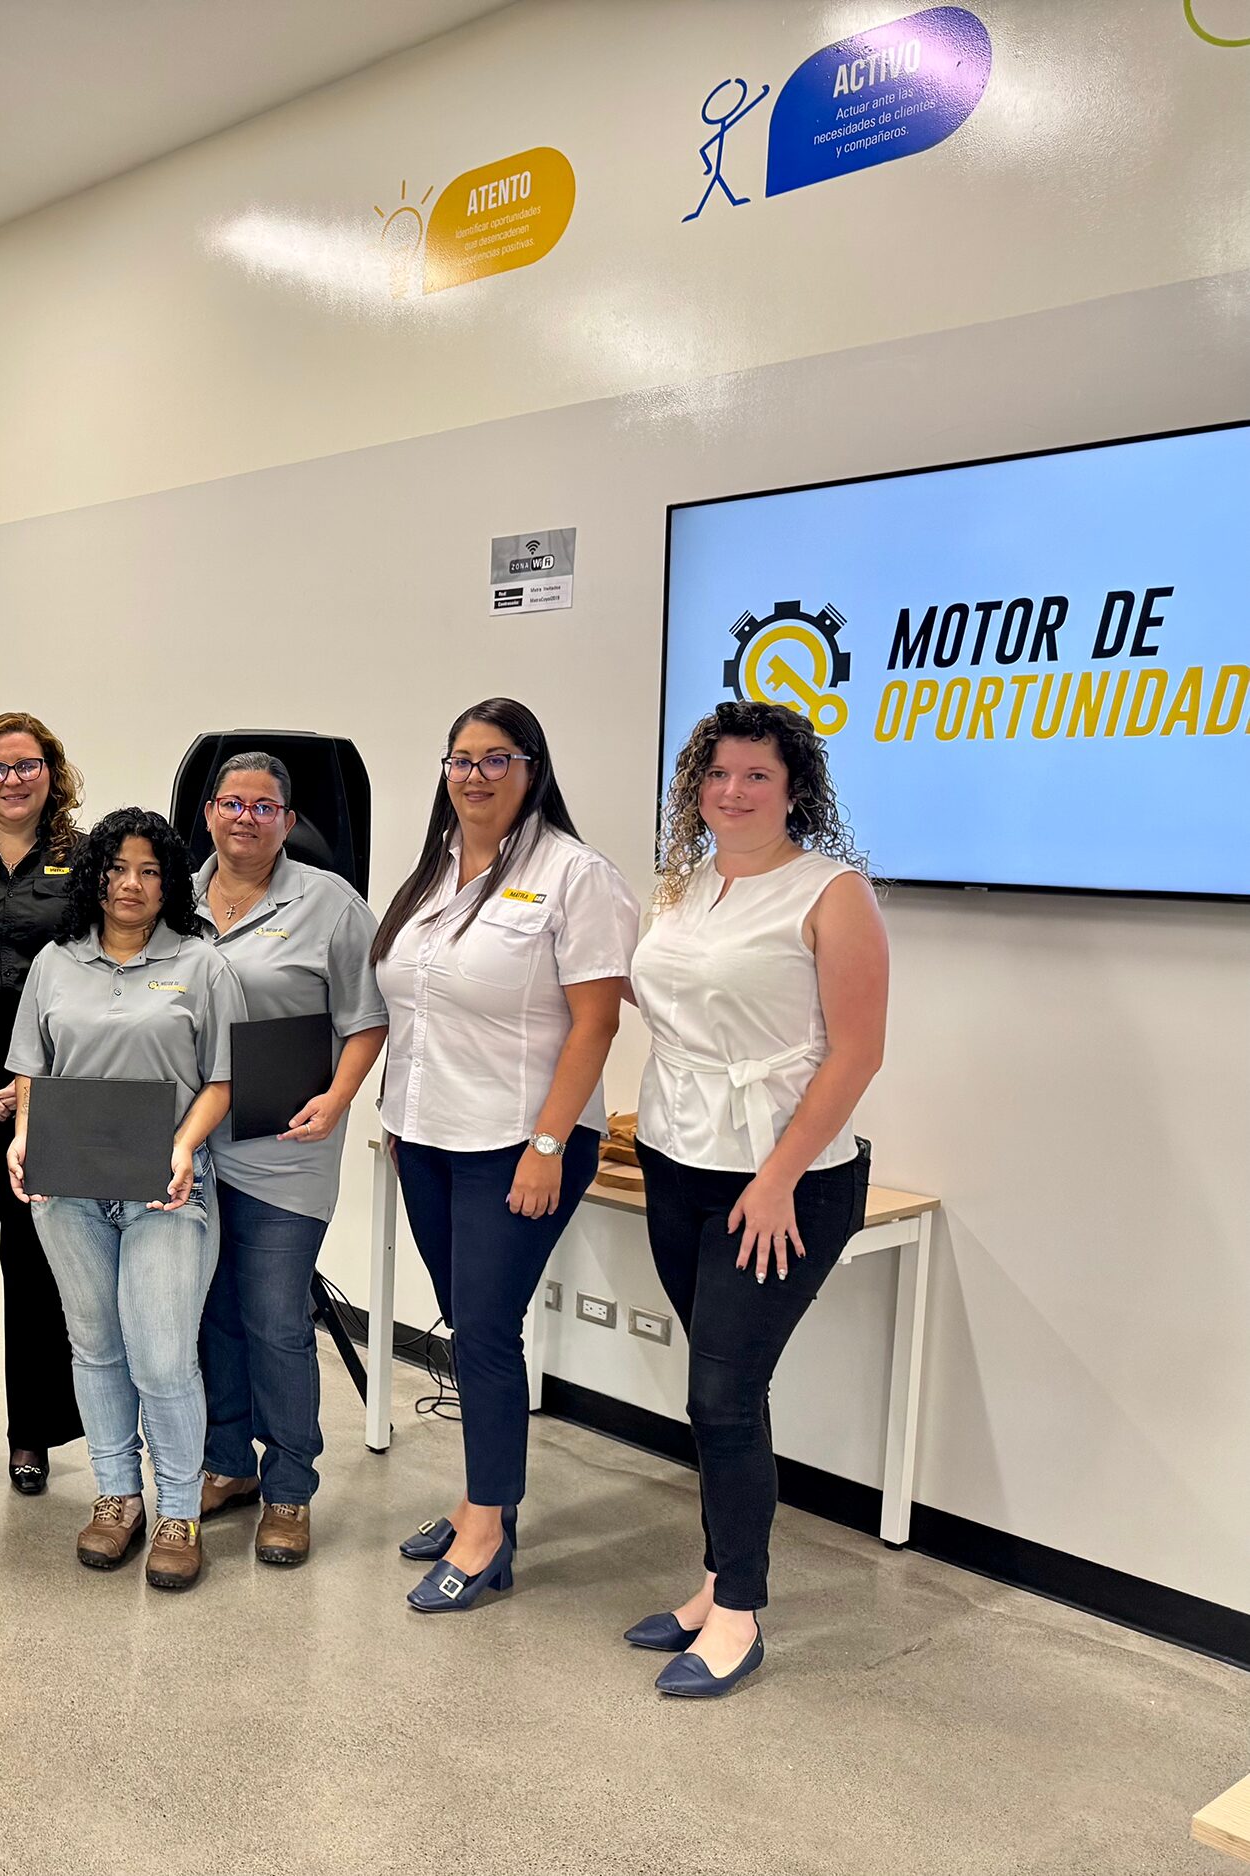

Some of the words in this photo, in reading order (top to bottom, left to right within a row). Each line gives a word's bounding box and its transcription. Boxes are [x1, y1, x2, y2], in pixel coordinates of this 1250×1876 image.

[833, 40, 921, 98] ACTIVO
[813, 118, 876, 145] necesidades
[878, 112, 892, 125] de
[894, 100, 936, 120] clientes
[835, 101, 870, 120] Actuar
[872, 93, 895, 109] ante
[898, 87, 914, 100] las
[835, 146, 842, 158] y
[844, 126, 909, 153] compañeros.
[467, 170, 531, 217] ATENTO
[490, 206, 541, 229] oportunidades
[511, 562, 529, 571] ZONA
[886, 595, 1070, 670] MOTOR
[1090, 586, 1176, 660] DE
[872, 664, 1250, 743] OPORTUNIDAD
